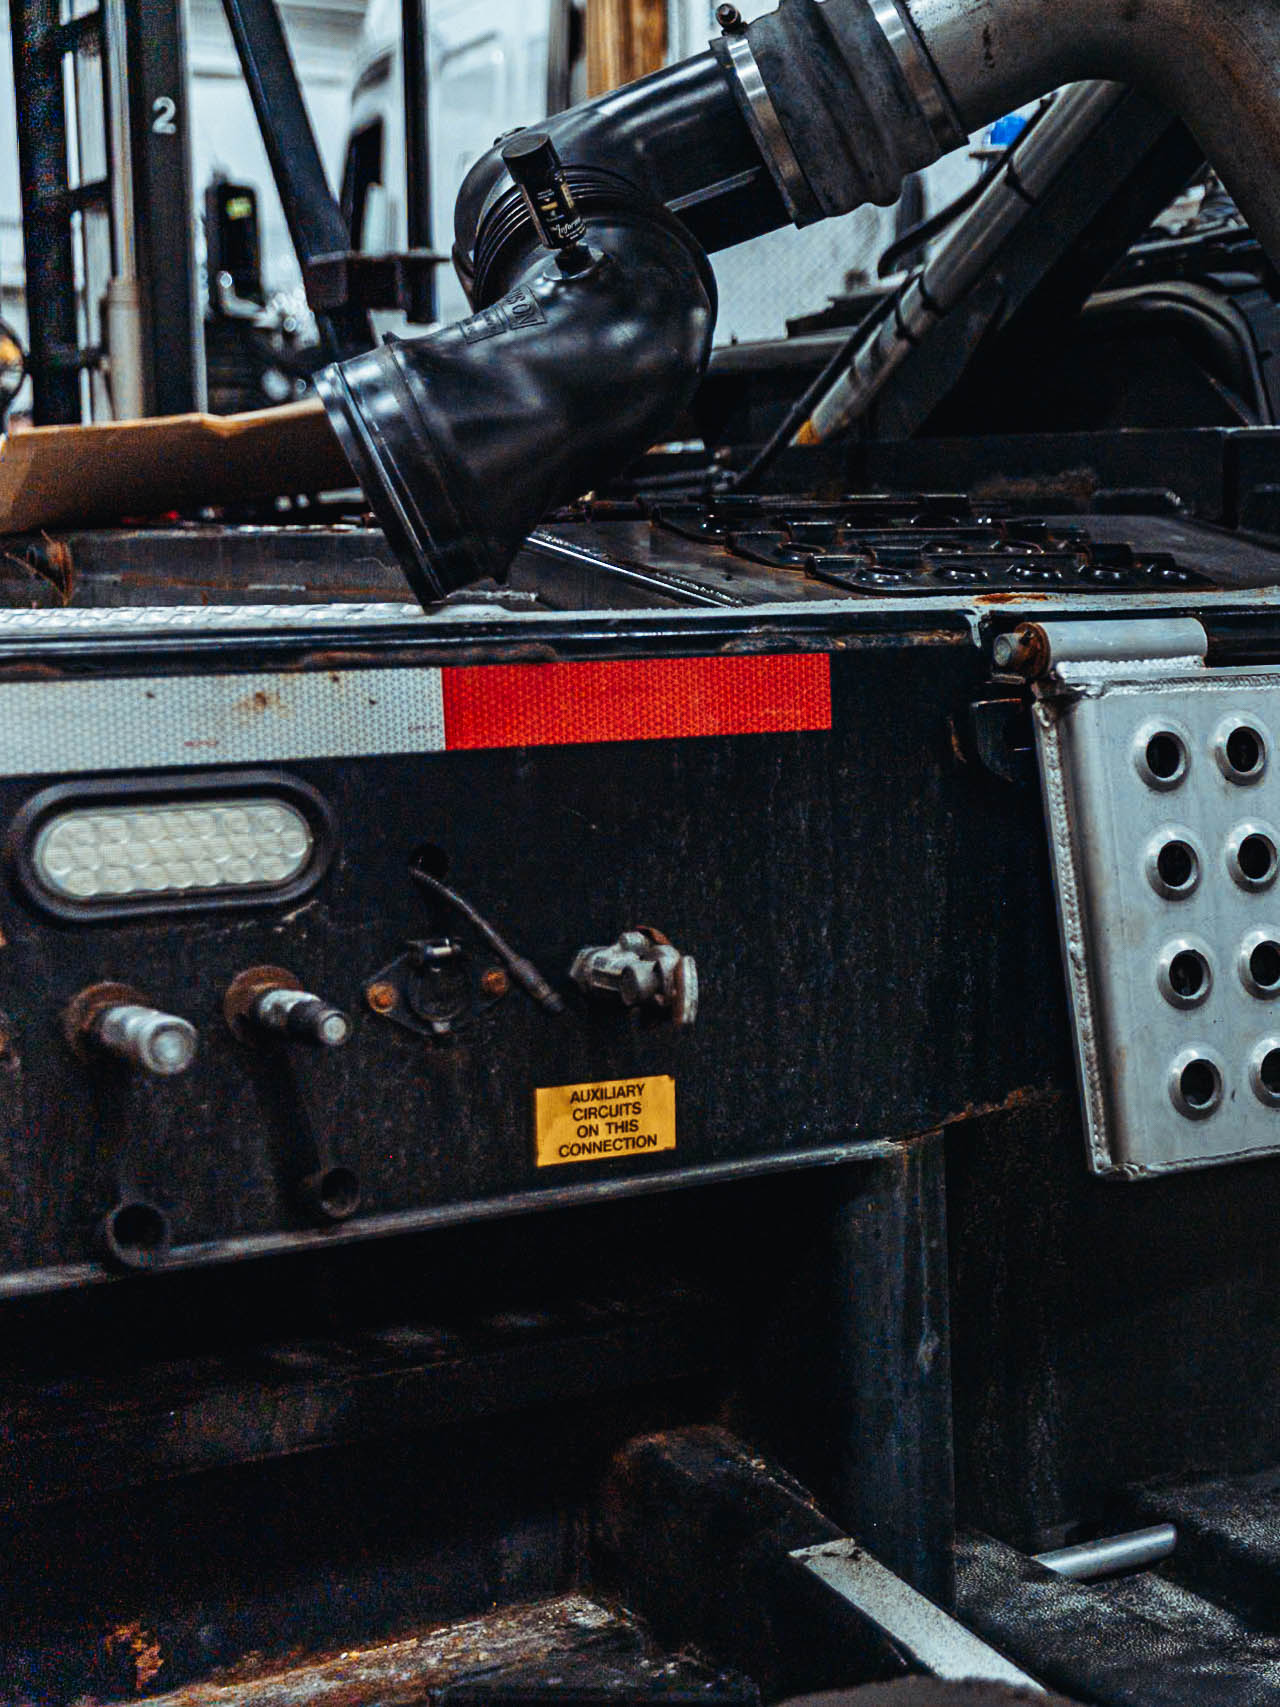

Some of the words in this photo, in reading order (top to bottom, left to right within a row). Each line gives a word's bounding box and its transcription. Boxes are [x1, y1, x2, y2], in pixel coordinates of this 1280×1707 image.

[151, 96, 177, 134] 2
[570, 1083, 645, 1104] AUXILIARY
[572, 1101, 642, 1121] CIRCUITS
[576, 1124, 599, 1138] ON
[605, 1119, 639, 1134] THIS
[558, 1133, 658, 1157] CONNECTION
